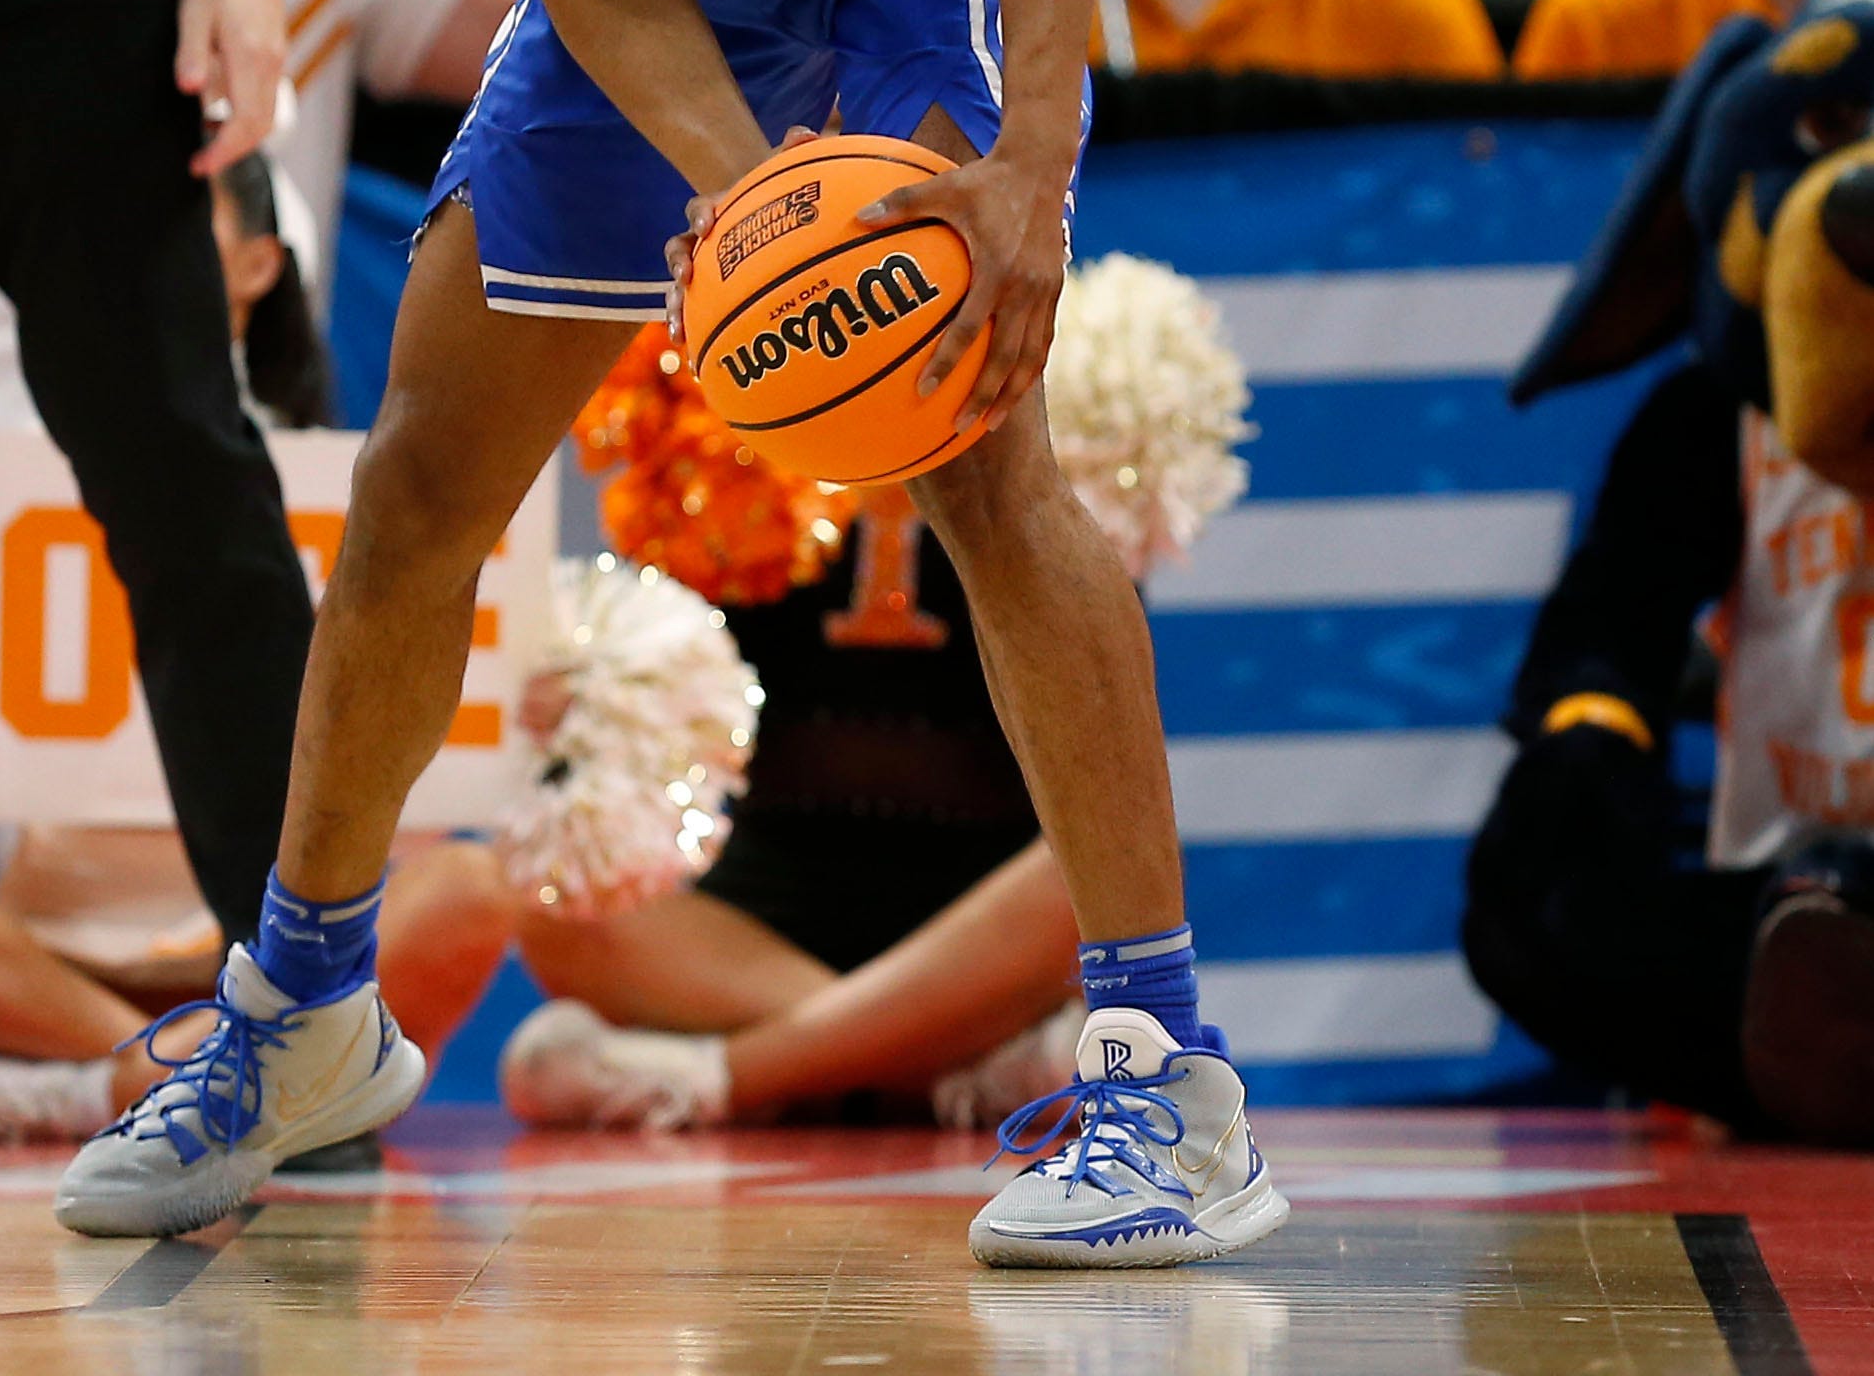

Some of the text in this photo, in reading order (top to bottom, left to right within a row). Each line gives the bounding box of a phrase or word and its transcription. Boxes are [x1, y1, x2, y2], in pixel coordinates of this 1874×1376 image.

[742, 210, 799, 257] MARCH
[719, 251, 941, 390] Wilson
[769, 278, 830, 321] EVO NXT
